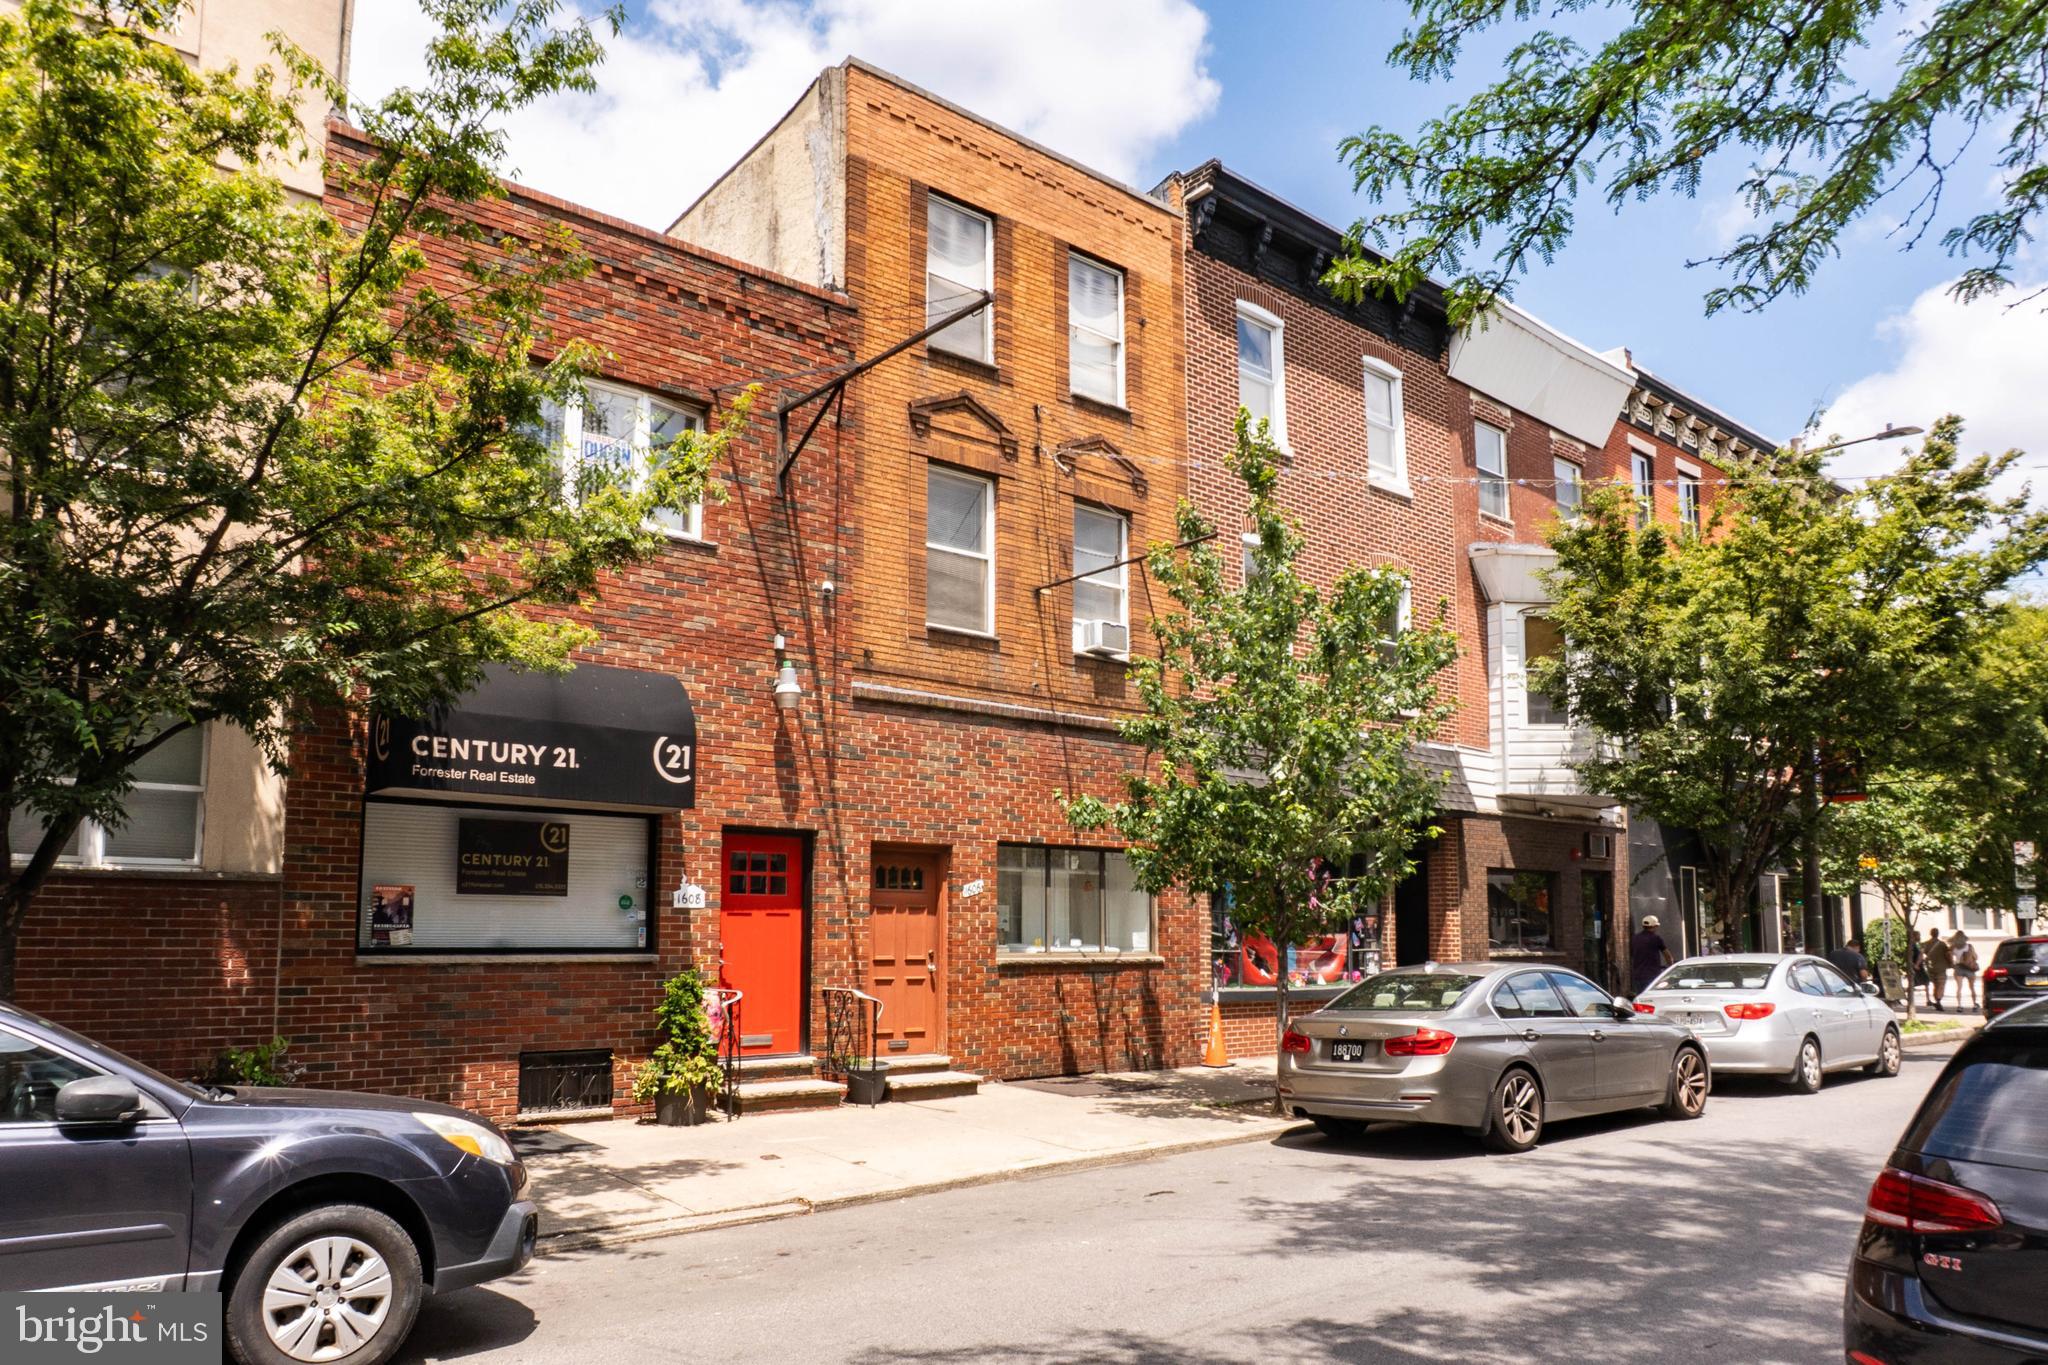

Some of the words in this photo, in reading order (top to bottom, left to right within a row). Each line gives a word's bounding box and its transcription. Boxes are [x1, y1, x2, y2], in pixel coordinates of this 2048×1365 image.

[411, 735, 547, 766] CENTURY
[412, 764, 467, 779] Forrester
[470, 769, 496, 782] Real
[500, 771, 536, 784] Estate
[462, 853, 532, 867] CENTURY
[677, 893, 701, 905] 1608
[1333, 1044, 1362, 1056] 188700
[1923, 1253, 1962, 1271] GTI
